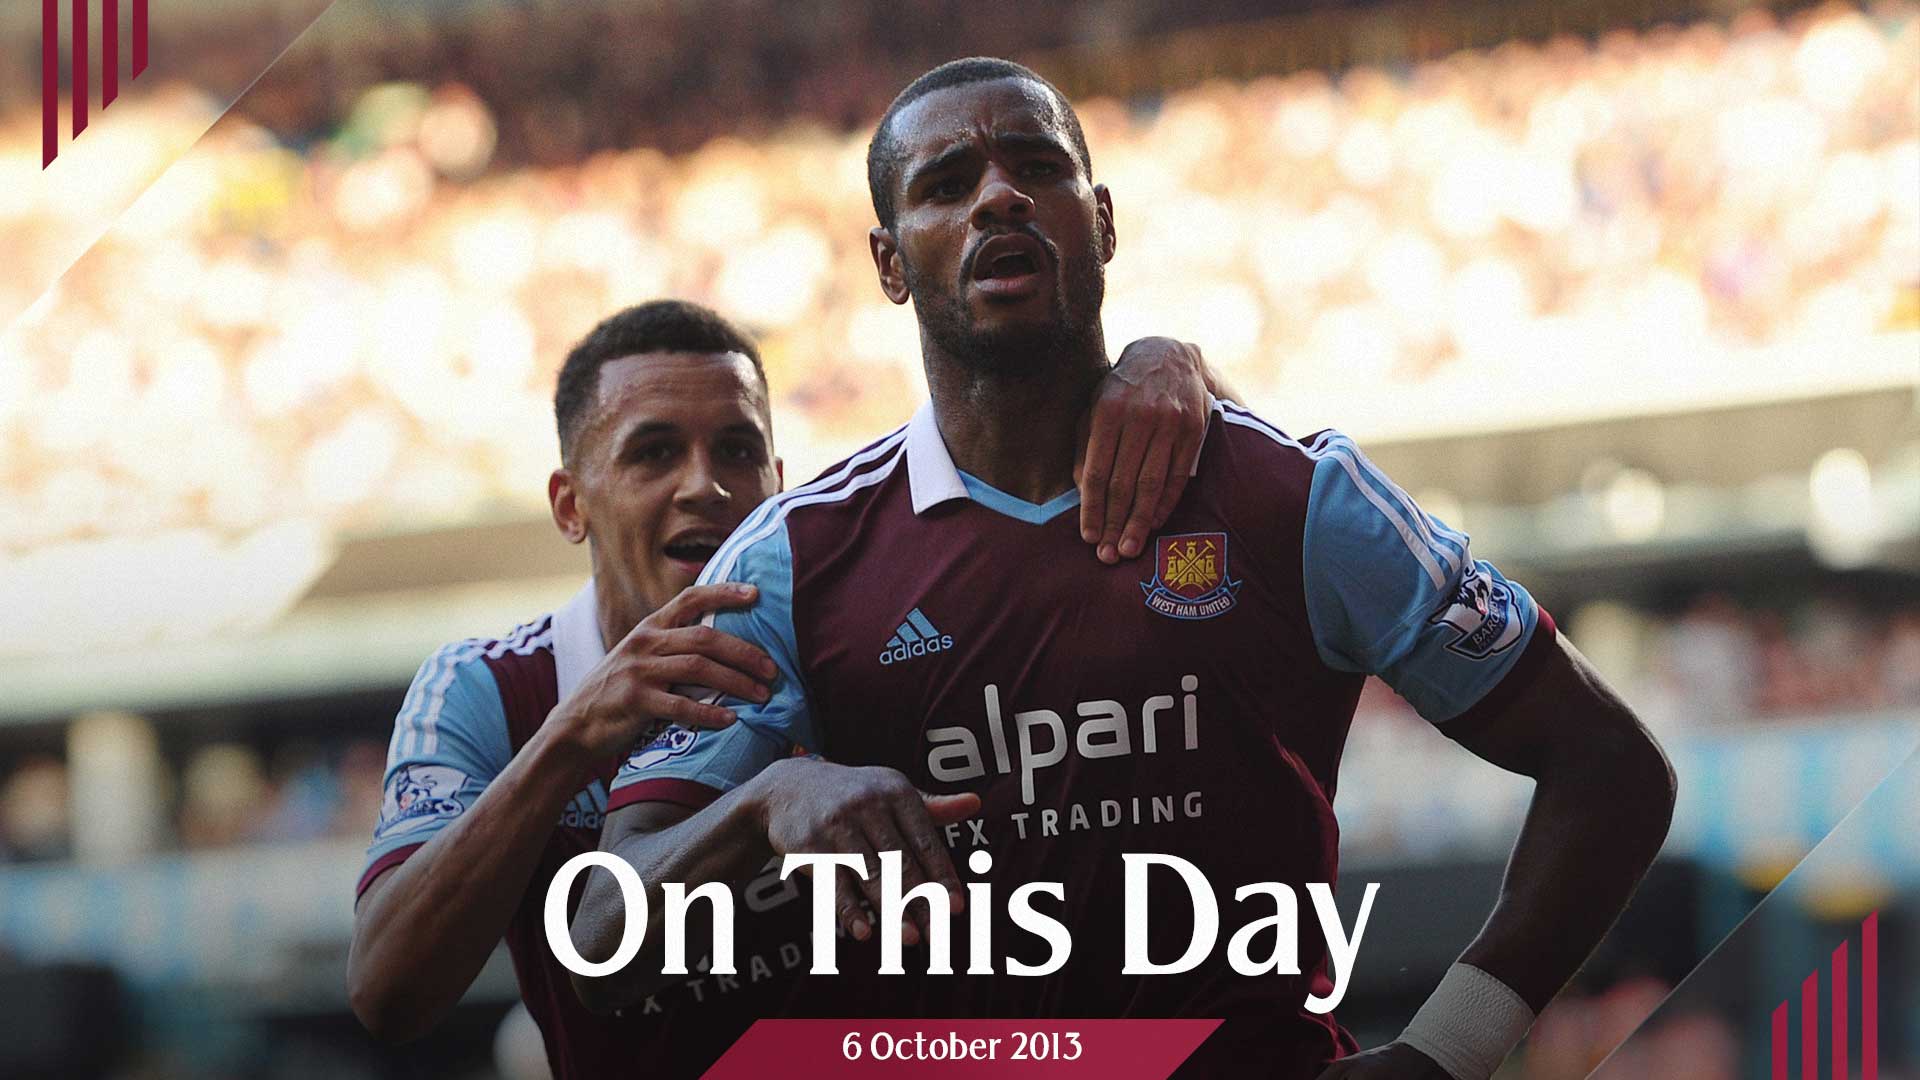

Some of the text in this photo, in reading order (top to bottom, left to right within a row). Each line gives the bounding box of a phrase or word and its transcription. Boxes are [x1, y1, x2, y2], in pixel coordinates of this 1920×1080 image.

[1152, 595, 1231, 617] WEST HAM UNITED
[879, 634, 954, 665] adidas
[926, 674, 1199, 805] alpari
[945, 791, 1202, 848] FX TRADING
